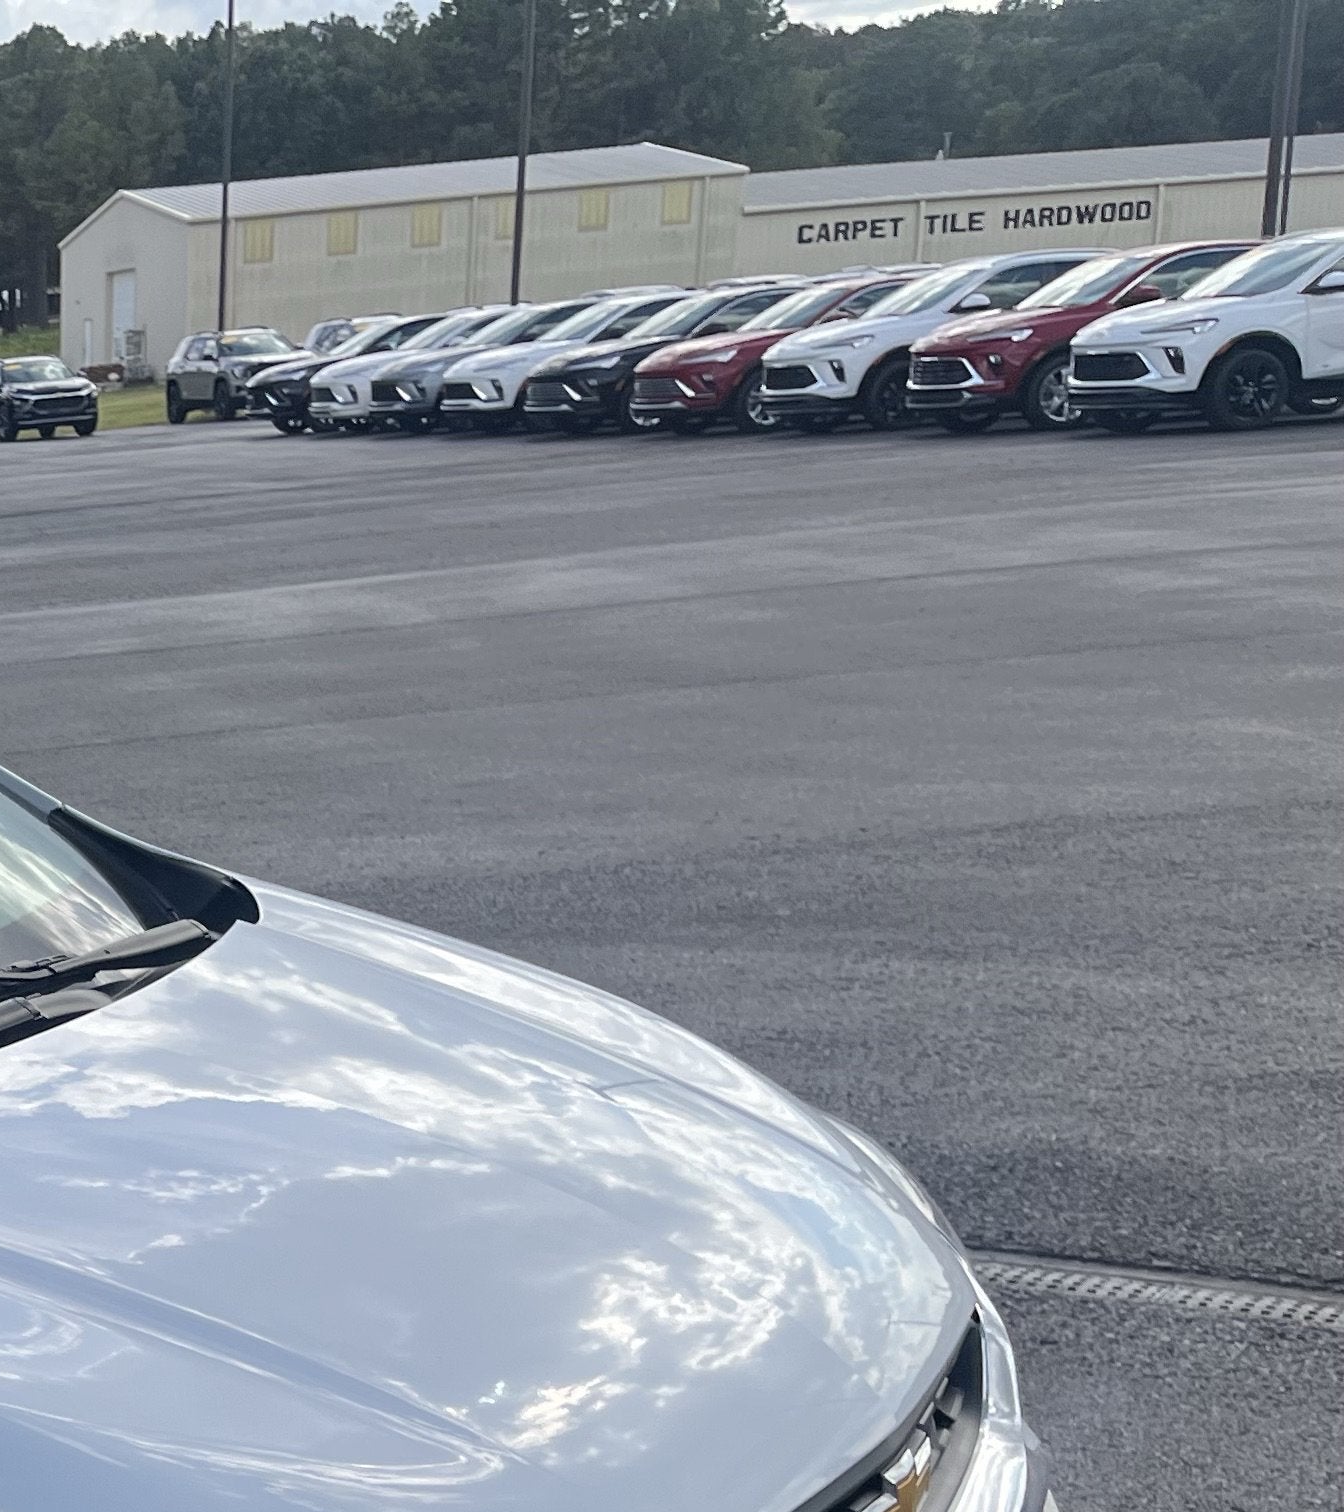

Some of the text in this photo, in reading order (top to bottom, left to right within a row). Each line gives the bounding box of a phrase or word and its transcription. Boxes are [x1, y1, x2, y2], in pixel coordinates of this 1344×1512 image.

[798, 200, 1152, 244] CARPET TILE HARDWOOD
